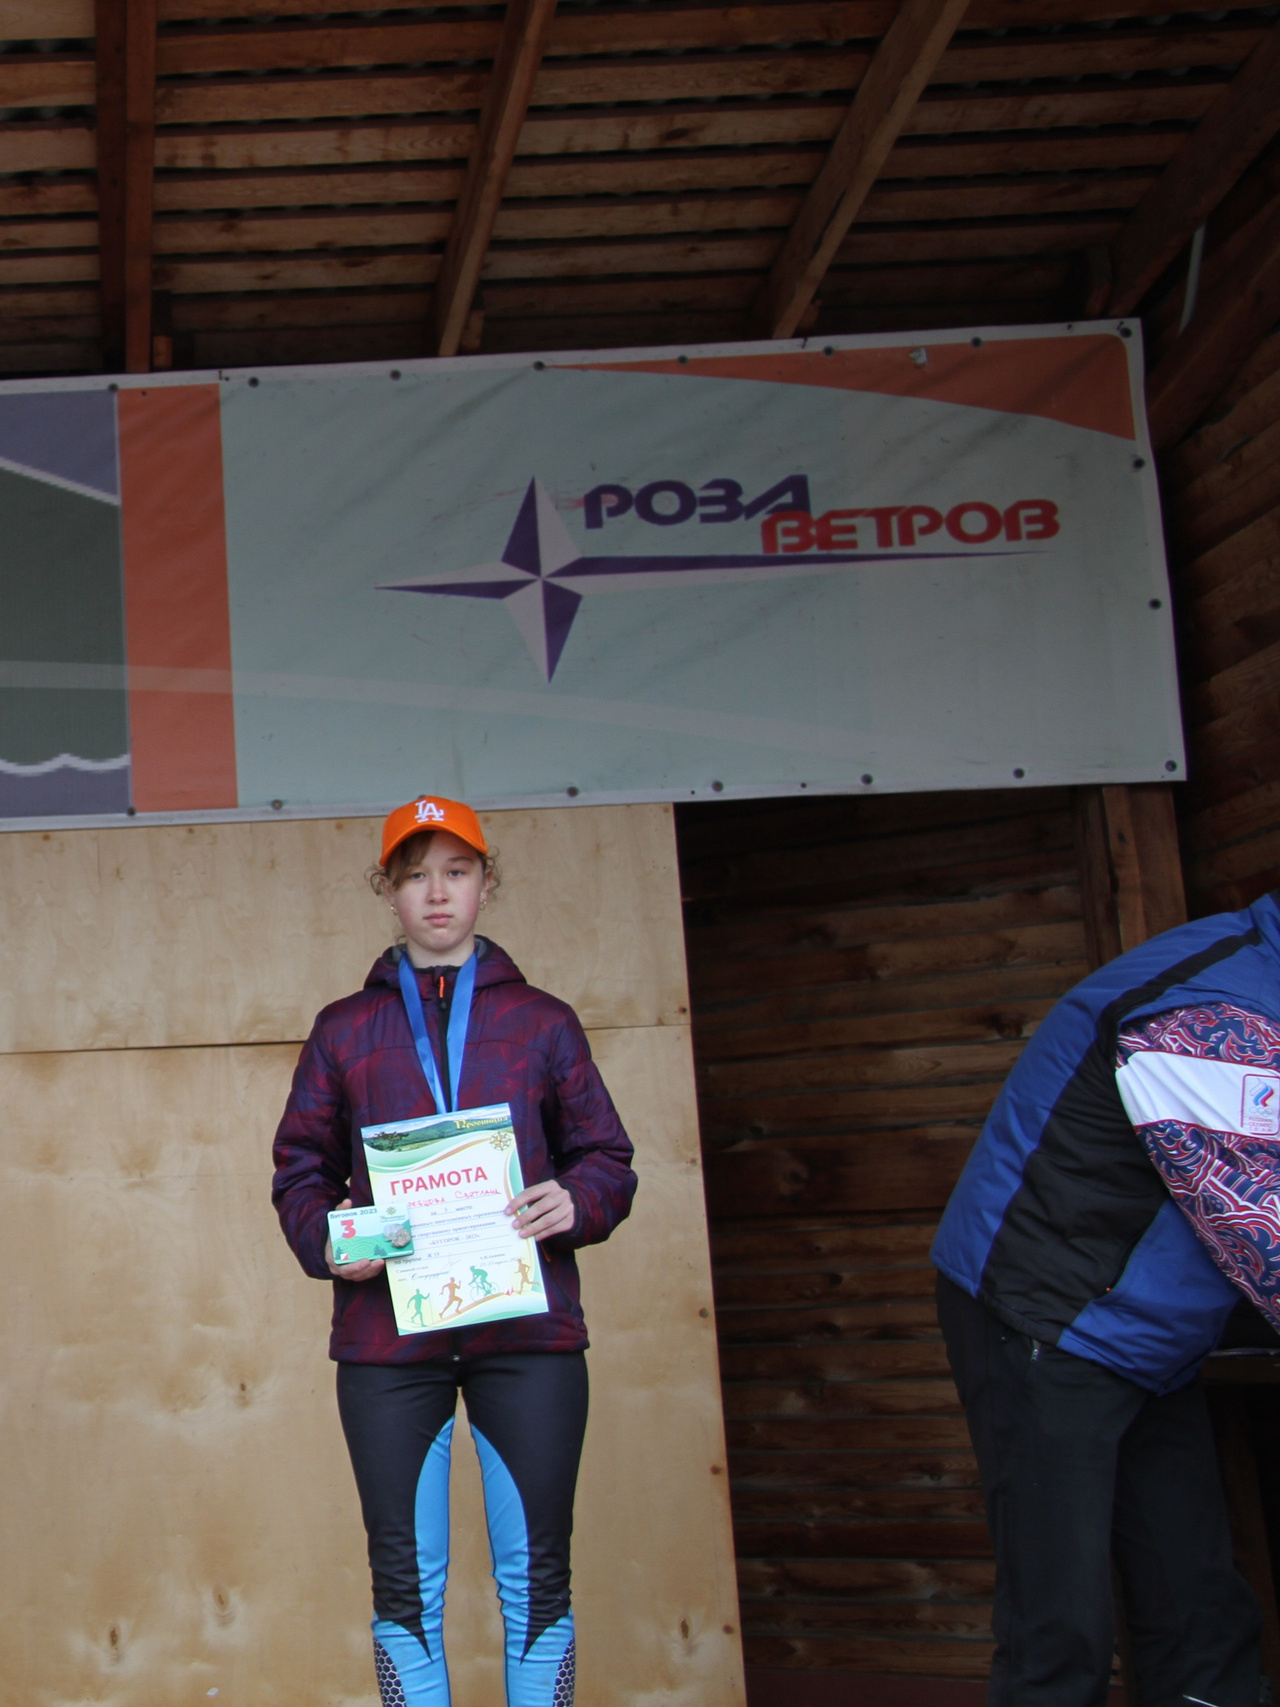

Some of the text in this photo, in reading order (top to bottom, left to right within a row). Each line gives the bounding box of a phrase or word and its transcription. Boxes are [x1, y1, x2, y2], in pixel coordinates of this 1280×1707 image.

[584, 474, 811, 529] РОЗА
[761, 499, 1060, 555] ВЕТРОВ
[414, 800, 445, 823] LA
[390, 1166, 488, 1195] ГРАМОТА
[359, 1208, 378, 1216] 2023
[340, 1219, 356, 1239] 3
